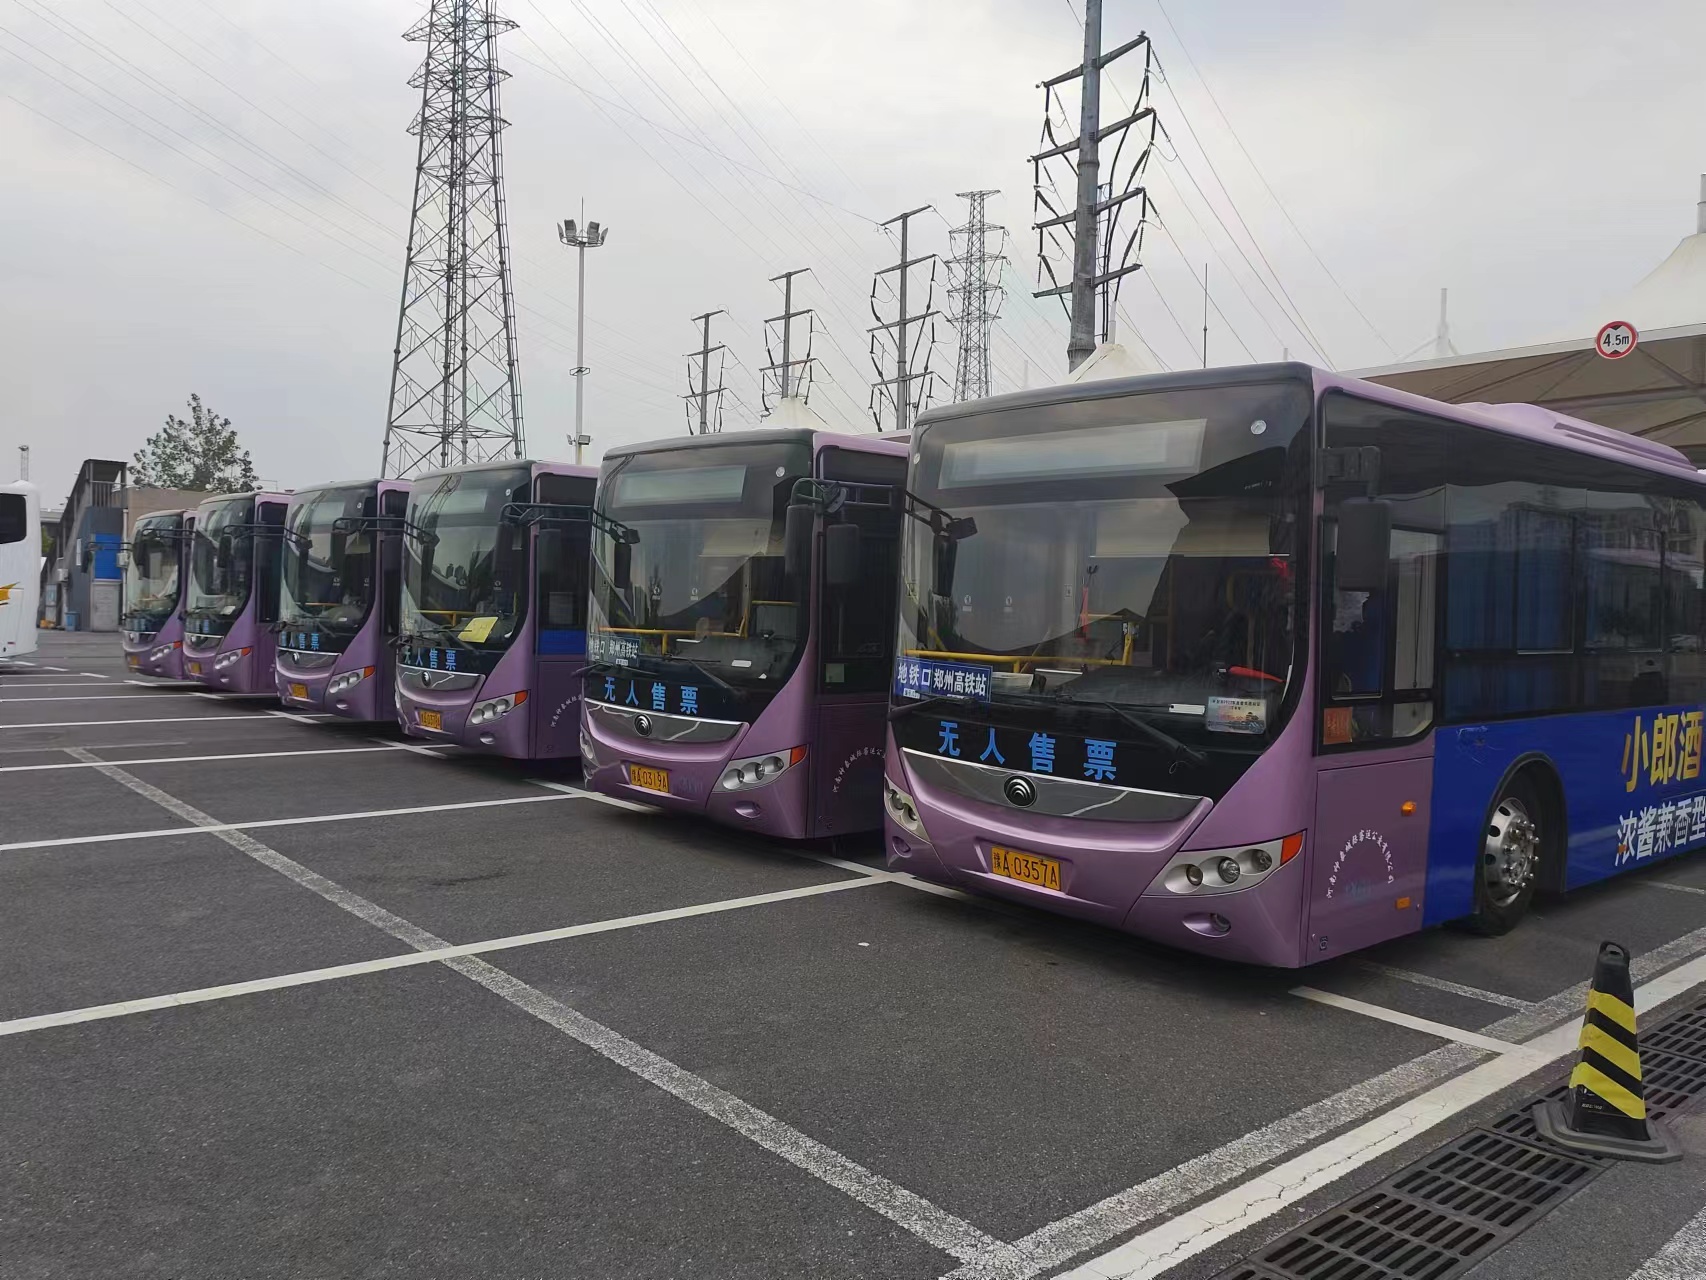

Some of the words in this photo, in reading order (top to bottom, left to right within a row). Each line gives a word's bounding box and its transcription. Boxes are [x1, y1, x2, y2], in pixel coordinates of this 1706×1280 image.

[1603, 333, 1630, 347] 4.5m
[604, 676, 699, 715] 无人售票
[897, 663, 932, 687] 地铁口
[933, 668, 987, 696] 郑州高铁站
[938, 721, 1117, 781] 无人售票
[1621, 711, 1704, 793] 小郎酒
[1614, 796, 1706, 867] 浓酱兼香型
